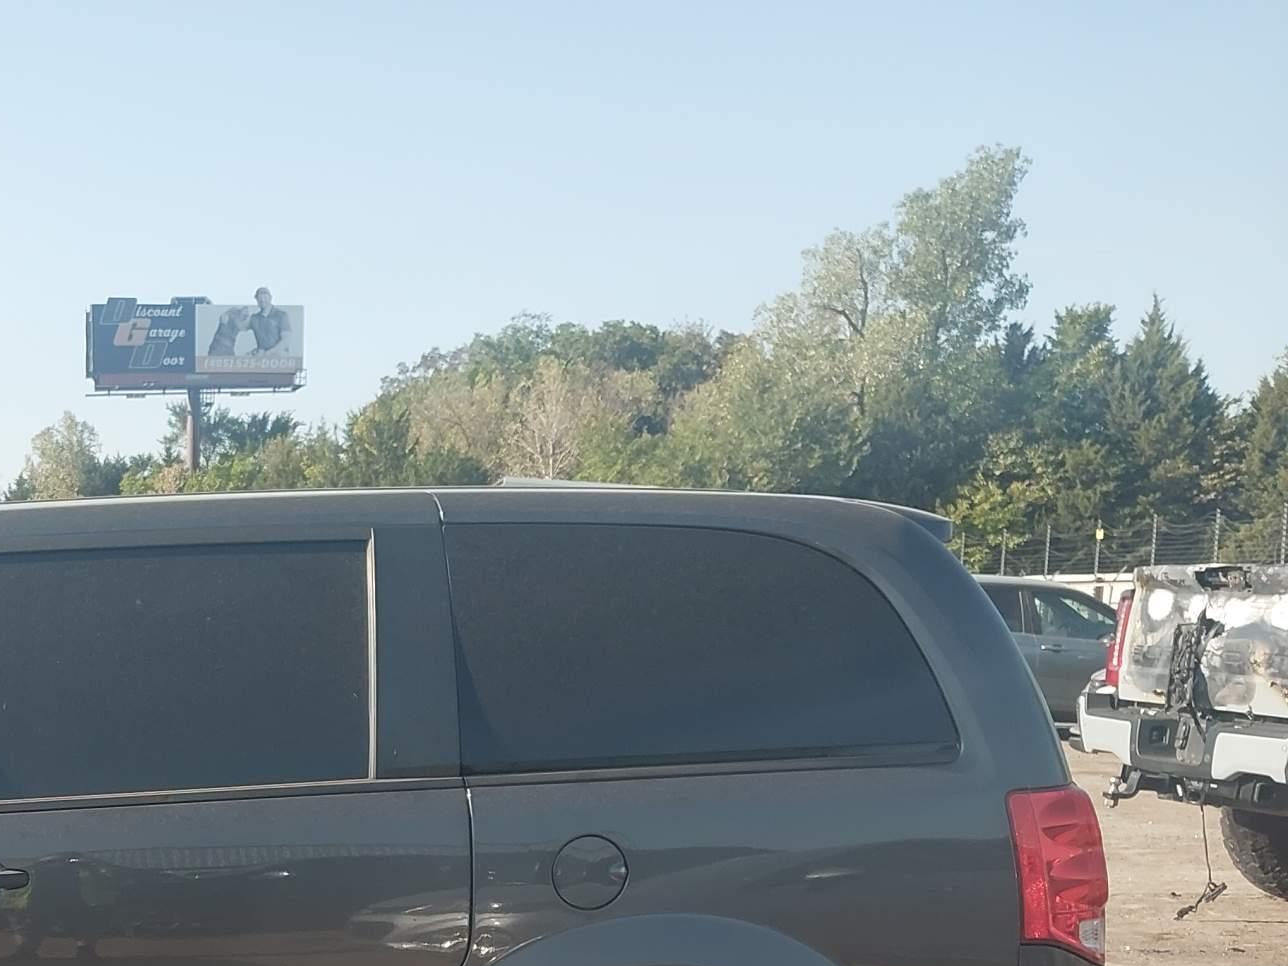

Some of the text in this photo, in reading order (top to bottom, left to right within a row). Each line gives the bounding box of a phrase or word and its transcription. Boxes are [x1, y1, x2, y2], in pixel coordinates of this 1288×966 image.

[99, 297, 183, 325] Discount
[113, 318, 186, 346] Garage
[128, 340, 185, 369] Door
